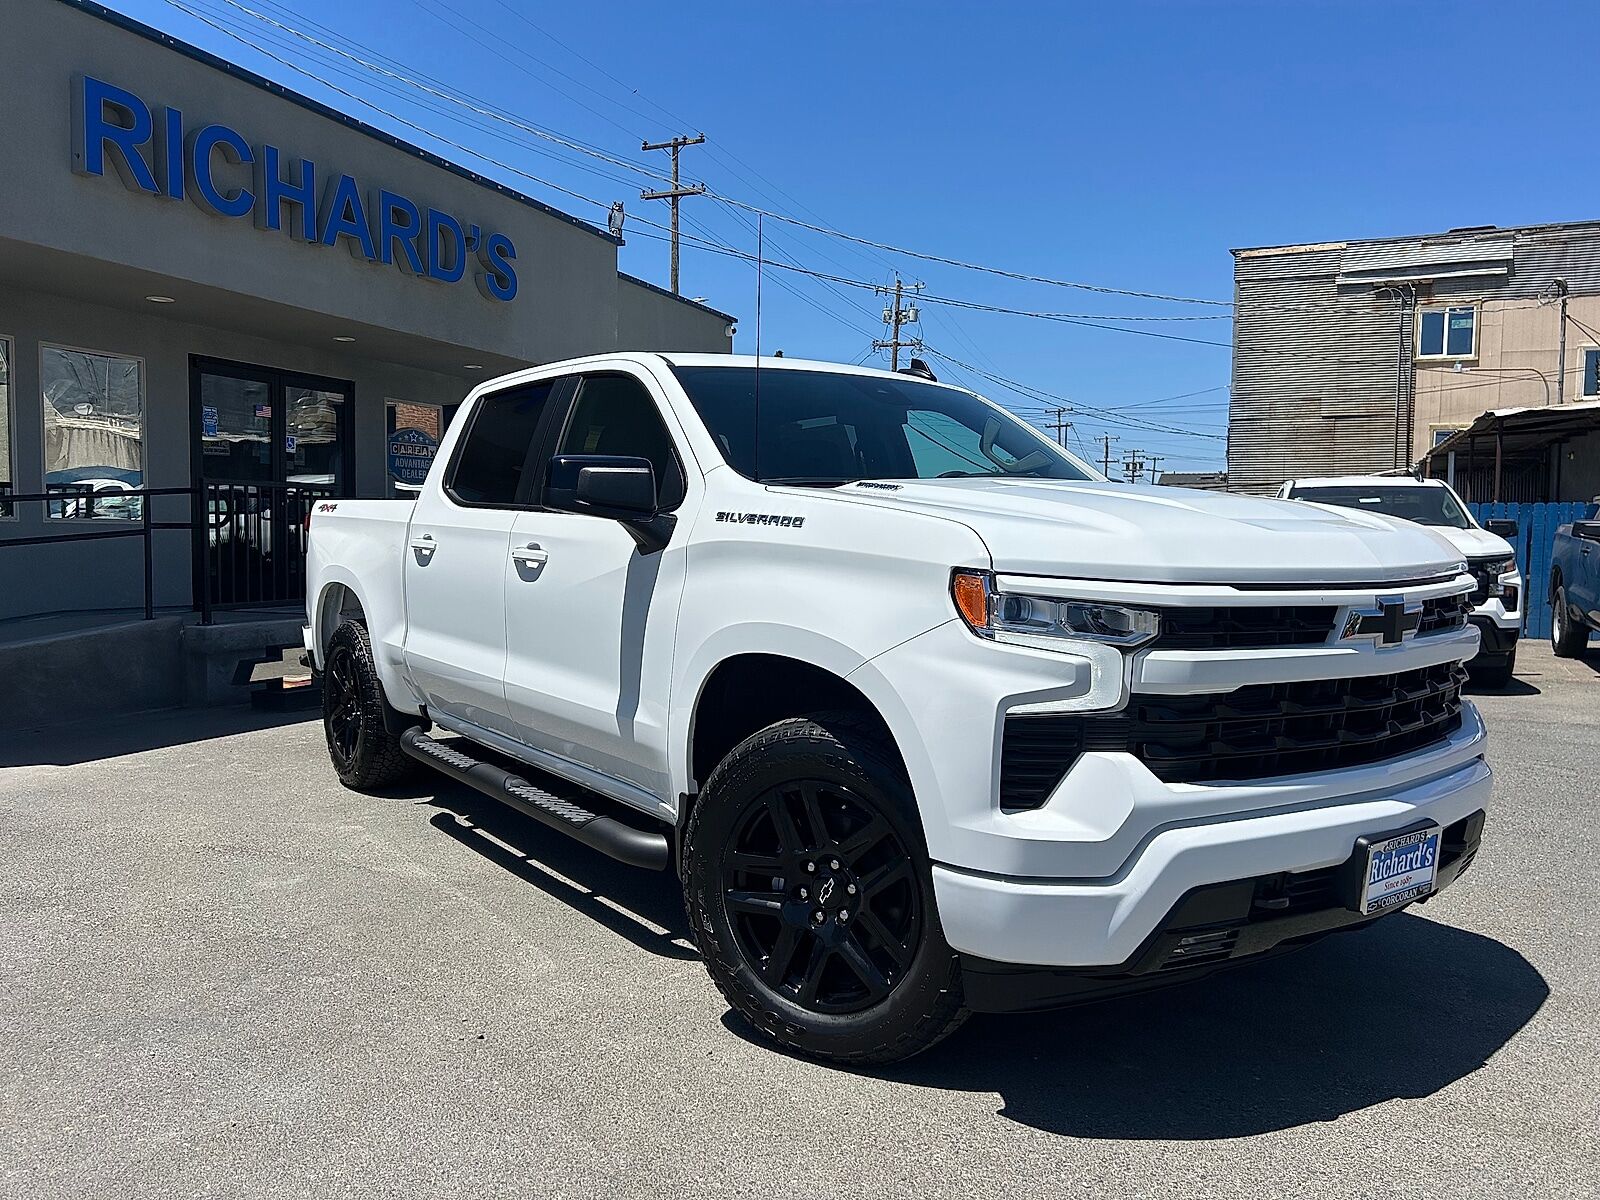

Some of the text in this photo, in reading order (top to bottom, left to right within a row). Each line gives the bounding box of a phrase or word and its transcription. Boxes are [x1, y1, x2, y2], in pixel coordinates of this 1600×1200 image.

[81, 75, 518, 301] RICHARD'S
[401, 468, 427, 480] DEALER
[715, 511, 805, 528] SILVERADO
[1370, 844, 1433, 883] Richard's
[1384, 880, 1400, 891] Since
[1381, 888, 1418, 907] CORCORAN
